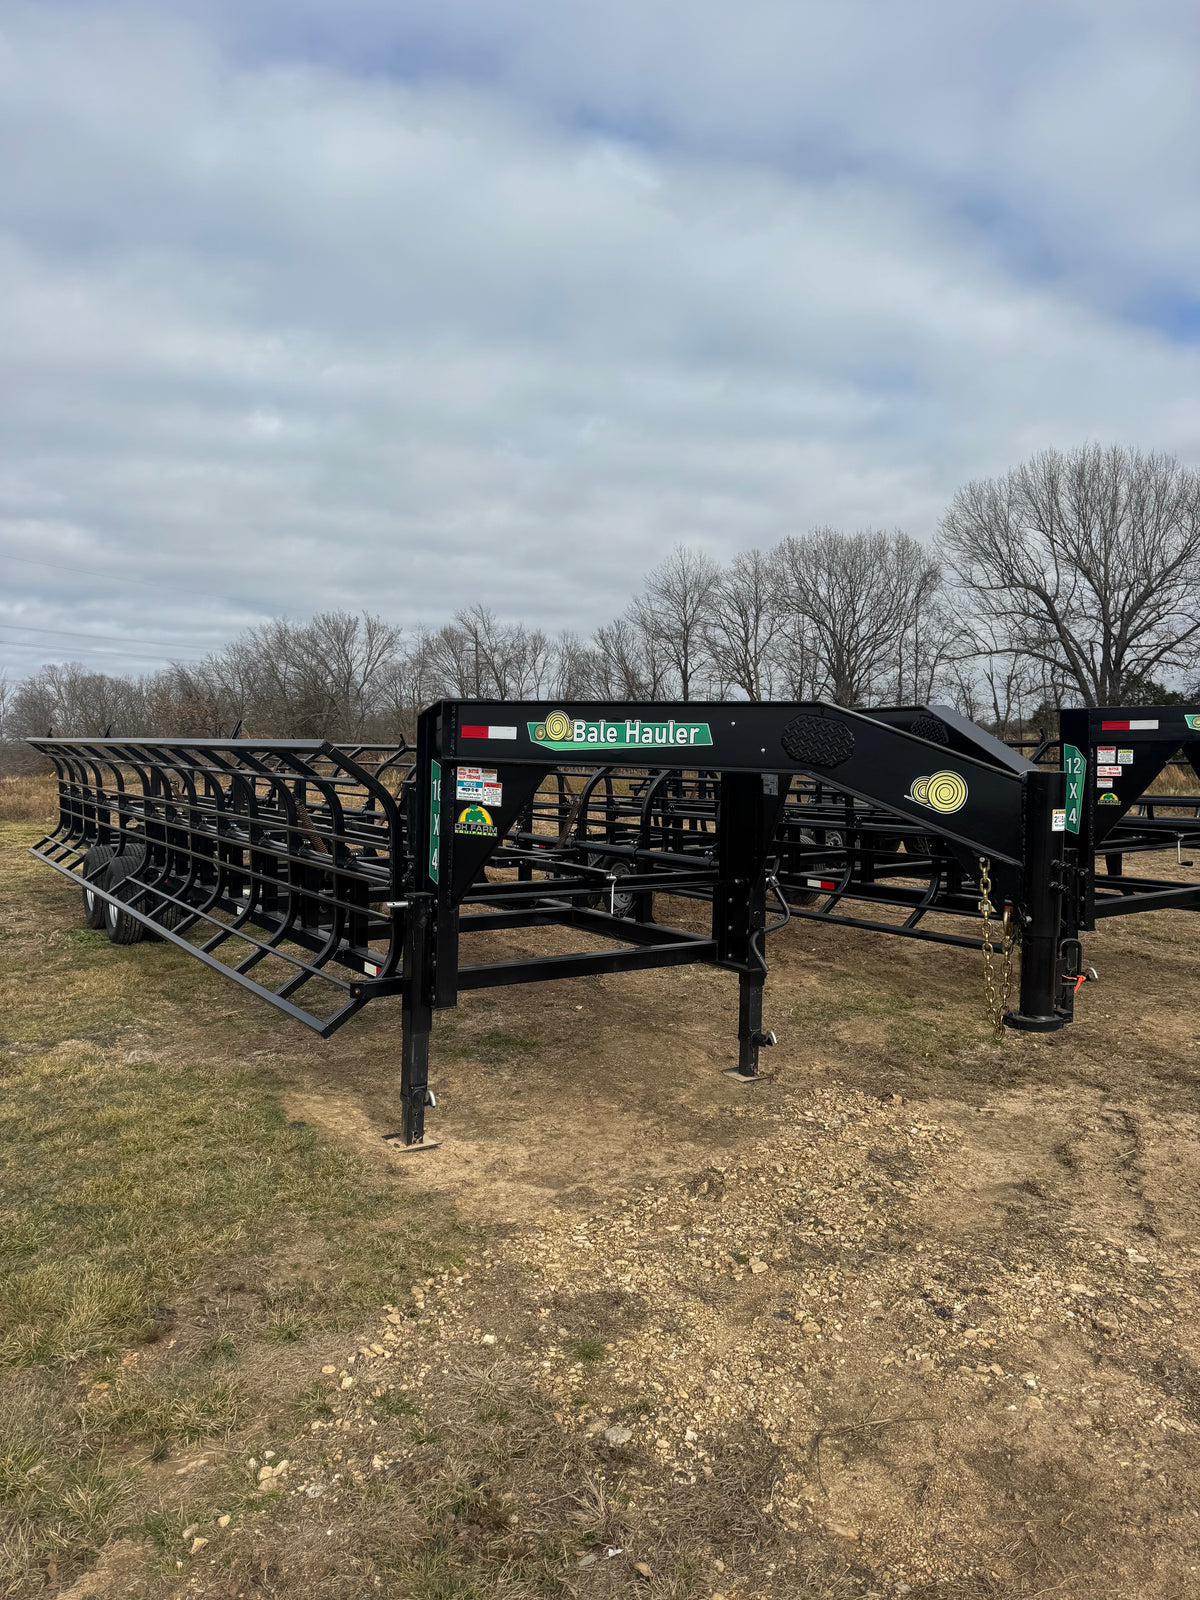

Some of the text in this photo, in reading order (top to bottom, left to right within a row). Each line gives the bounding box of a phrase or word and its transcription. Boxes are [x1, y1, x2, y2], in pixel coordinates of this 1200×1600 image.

[573, 720, 700, 744] Bale Hauler
[1066, 757, 1081, 824] 12 X 4
[433, 814, 440, 836] X
[470, 824, 498, 833] FARM
[431, 848, 438, 870] 4
